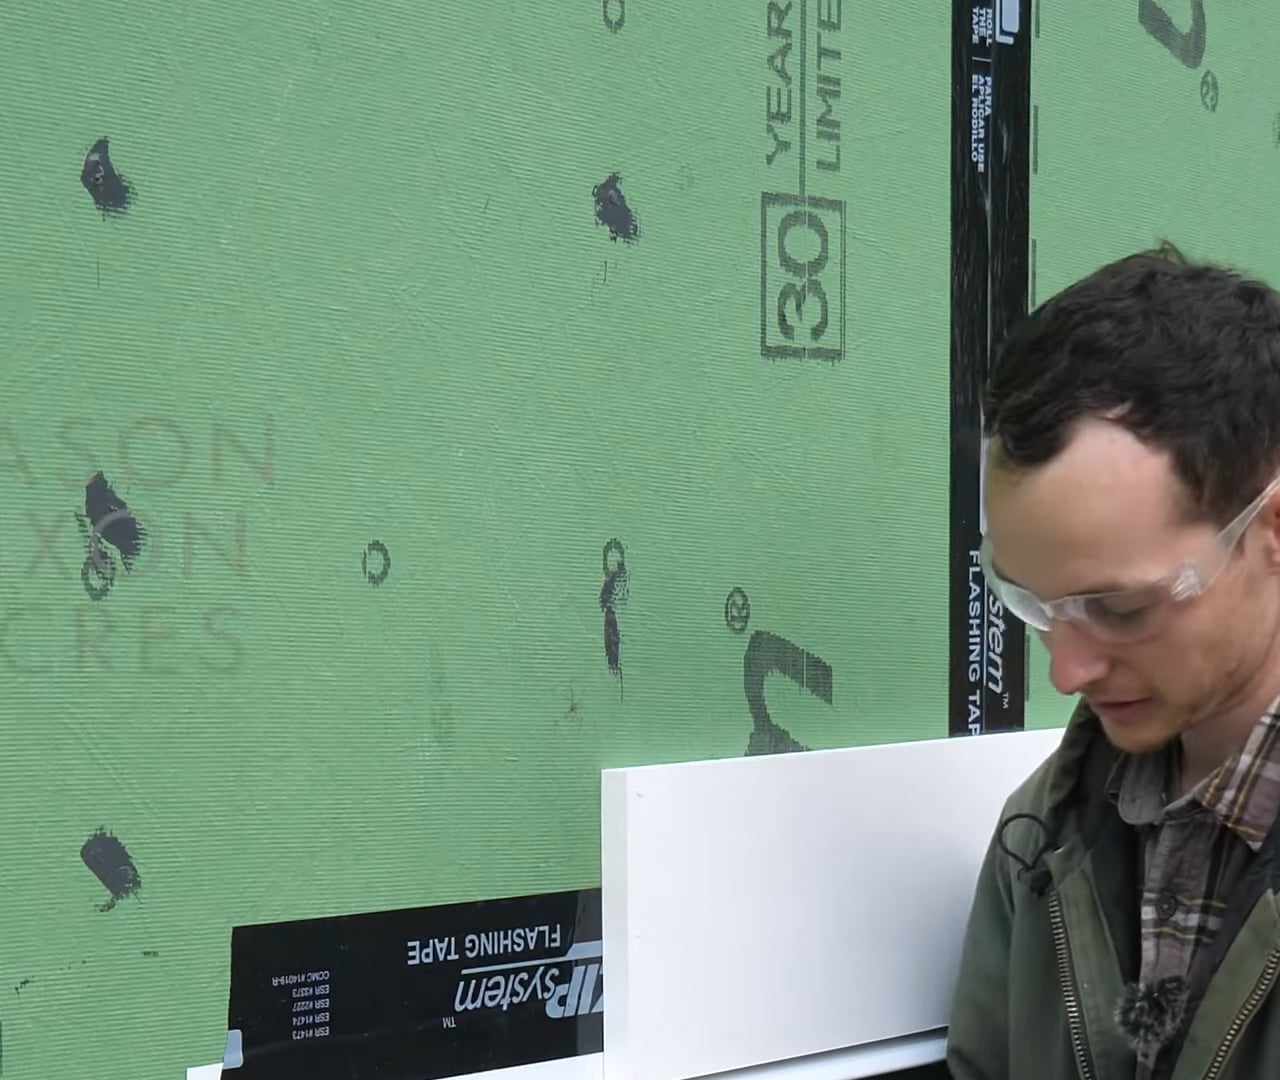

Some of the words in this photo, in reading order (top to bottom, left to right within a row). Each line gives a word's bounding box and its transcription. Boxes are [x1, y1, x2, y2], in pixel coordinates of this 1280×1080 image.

[971, 5, 980, 44] TAPE
[978, 7, 987, 38] THE
[985, 8, 993, 47] ROLL
[765, 0, 793, 166] YEAR
[971, 74, 980, 93] EL
[984, 75, 993, 117] PARA
[977, 74, 986, 139] APLICAR
[971, 97, 980, 163] RODILLO
[977, 141, 986, 173] USE
[775, 208, 831, 343] 30
[968, 550, 981, 683] FLASHING
[968, 689, 981, 736] TAP
[407, 936, 460, 966] TAPE
[464, 923, 562, 959] FLASHING
[314, 984, 330, 995] ESR
[314, 998, 330, 1009] ESR
[314, 1012, 330, 1023] ESR
[314, 1026, 330, 1037] ESR
